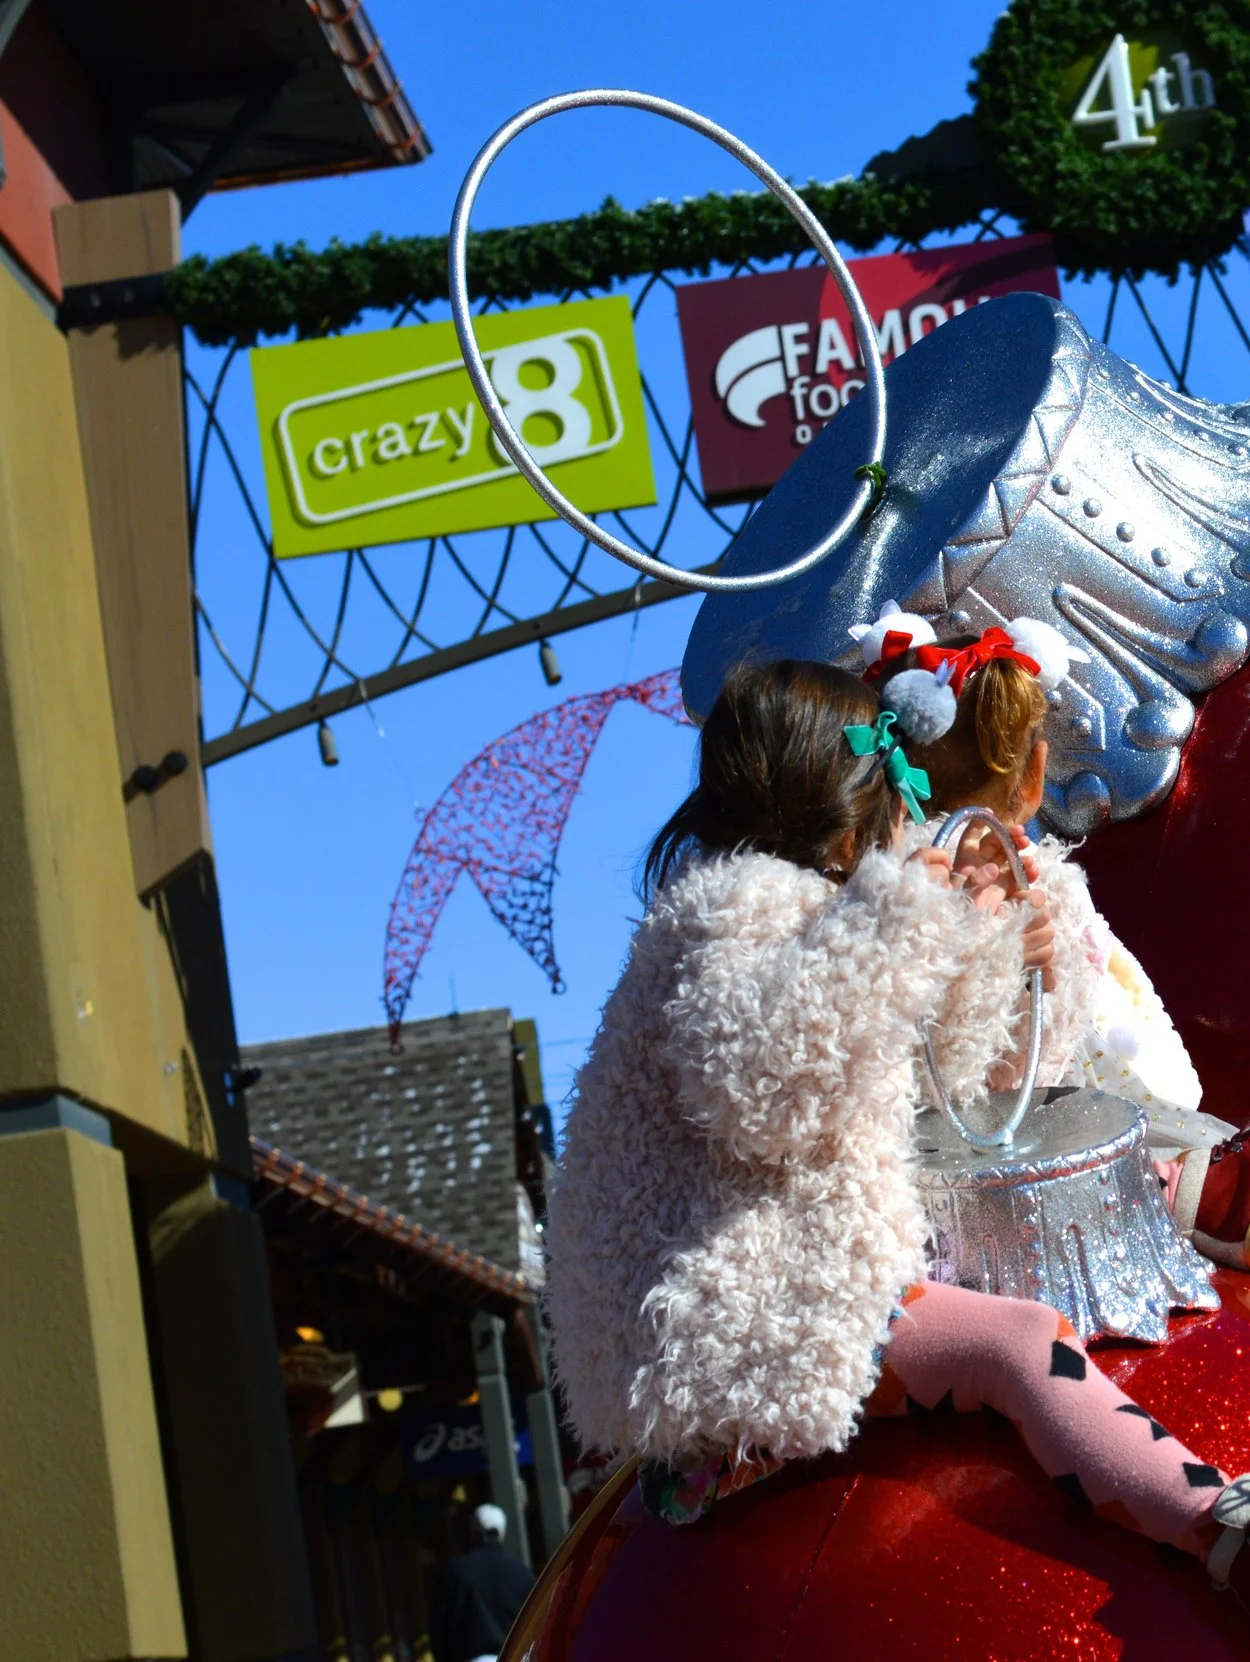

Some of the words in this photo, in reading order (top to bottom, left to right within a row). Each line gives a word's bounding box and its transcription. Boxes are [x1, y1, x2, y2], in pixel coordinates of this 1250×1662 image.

[1072, 33, 1216, 151] 4th
[781, 296, 991, 378] FAMO
[311, 402, 476, 477] crazy
[490, 329, 593, 467] 8
